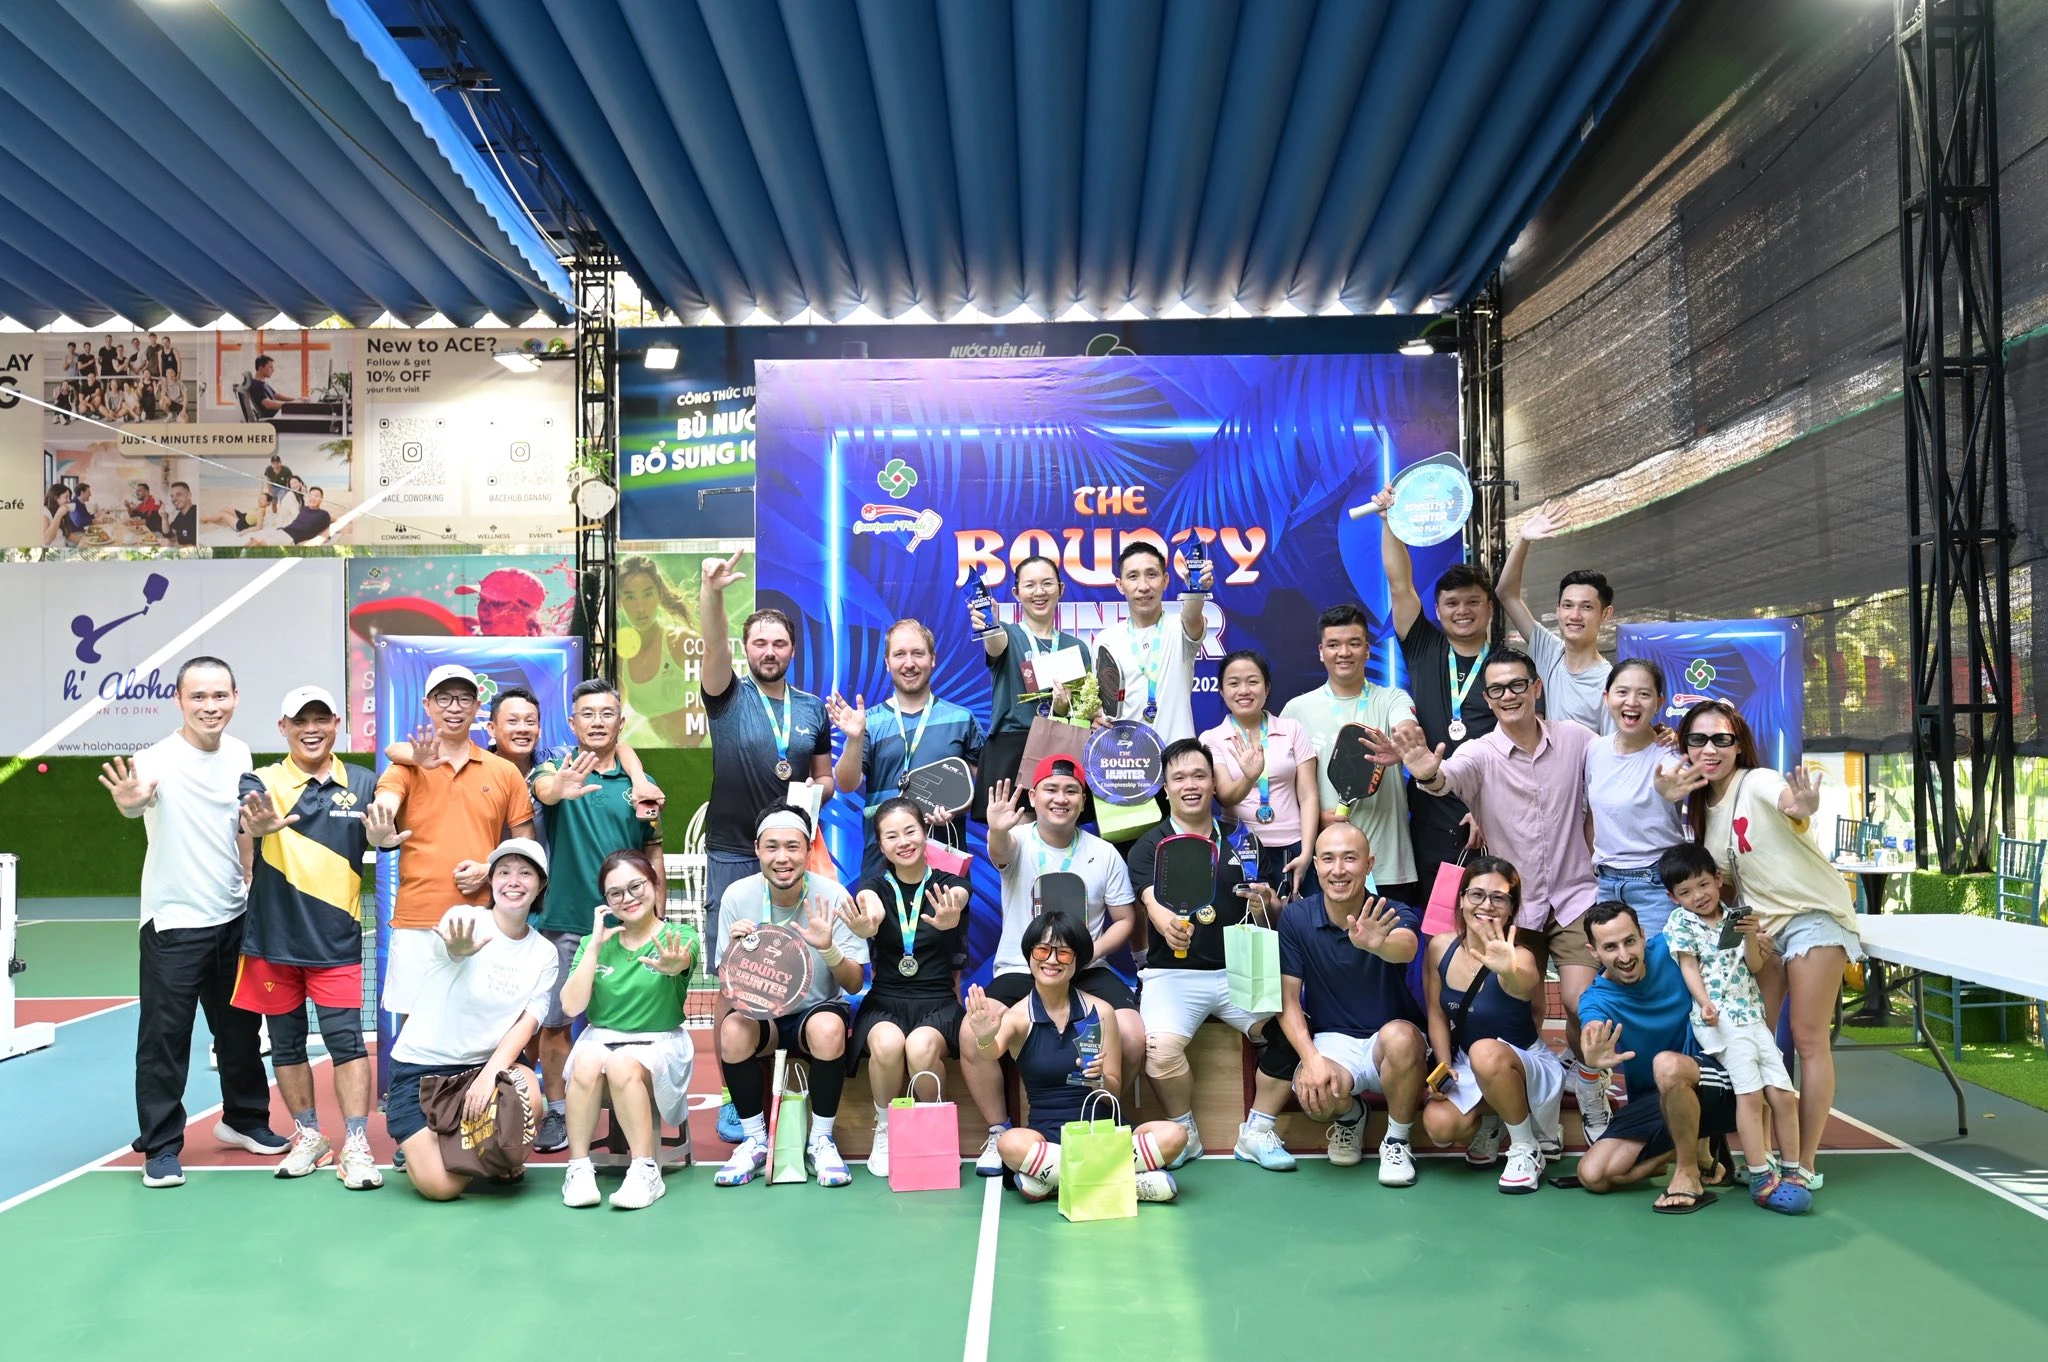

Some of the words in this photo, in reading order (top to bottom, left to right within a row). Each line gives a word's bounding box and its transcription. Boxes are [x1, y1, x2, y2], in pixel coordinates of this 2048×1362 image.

[367, 338, 413, 353] New
[419, 338, 439, 353] to
[444, 337, 497, 352] ACE?
[366, 358, 401, 366] Follow
[414, 359, 431, 368] get
[366, 370, 396, 382] 10%
[400, 370, 431, 382] OFF
[676, 391, 711, 406] CÔNG
[712, 386, 741, 402] THỨC
[677, 410, 707, 441] BÙ
[121, 436, 147, 445] JUST
[151, 436, 157, 444] 5
[160, 435, 208, 444] MINUTES
[212, 434, 244, 444] FROM
[247, 434, 274, 444] HERE
[630, 440, 667, 477] BỔ
[671, 441, 736, 472] SUNG
[1073, 485, 1148, 516] THE
[98, 667, 177, 701] Aloha
[115, 707, 129, 715] TO
[133, 706, 159, 715] DINK
[1105, 769, 1146, 780] HUNTER
[735, 969, 788, 1000] HUNTER
